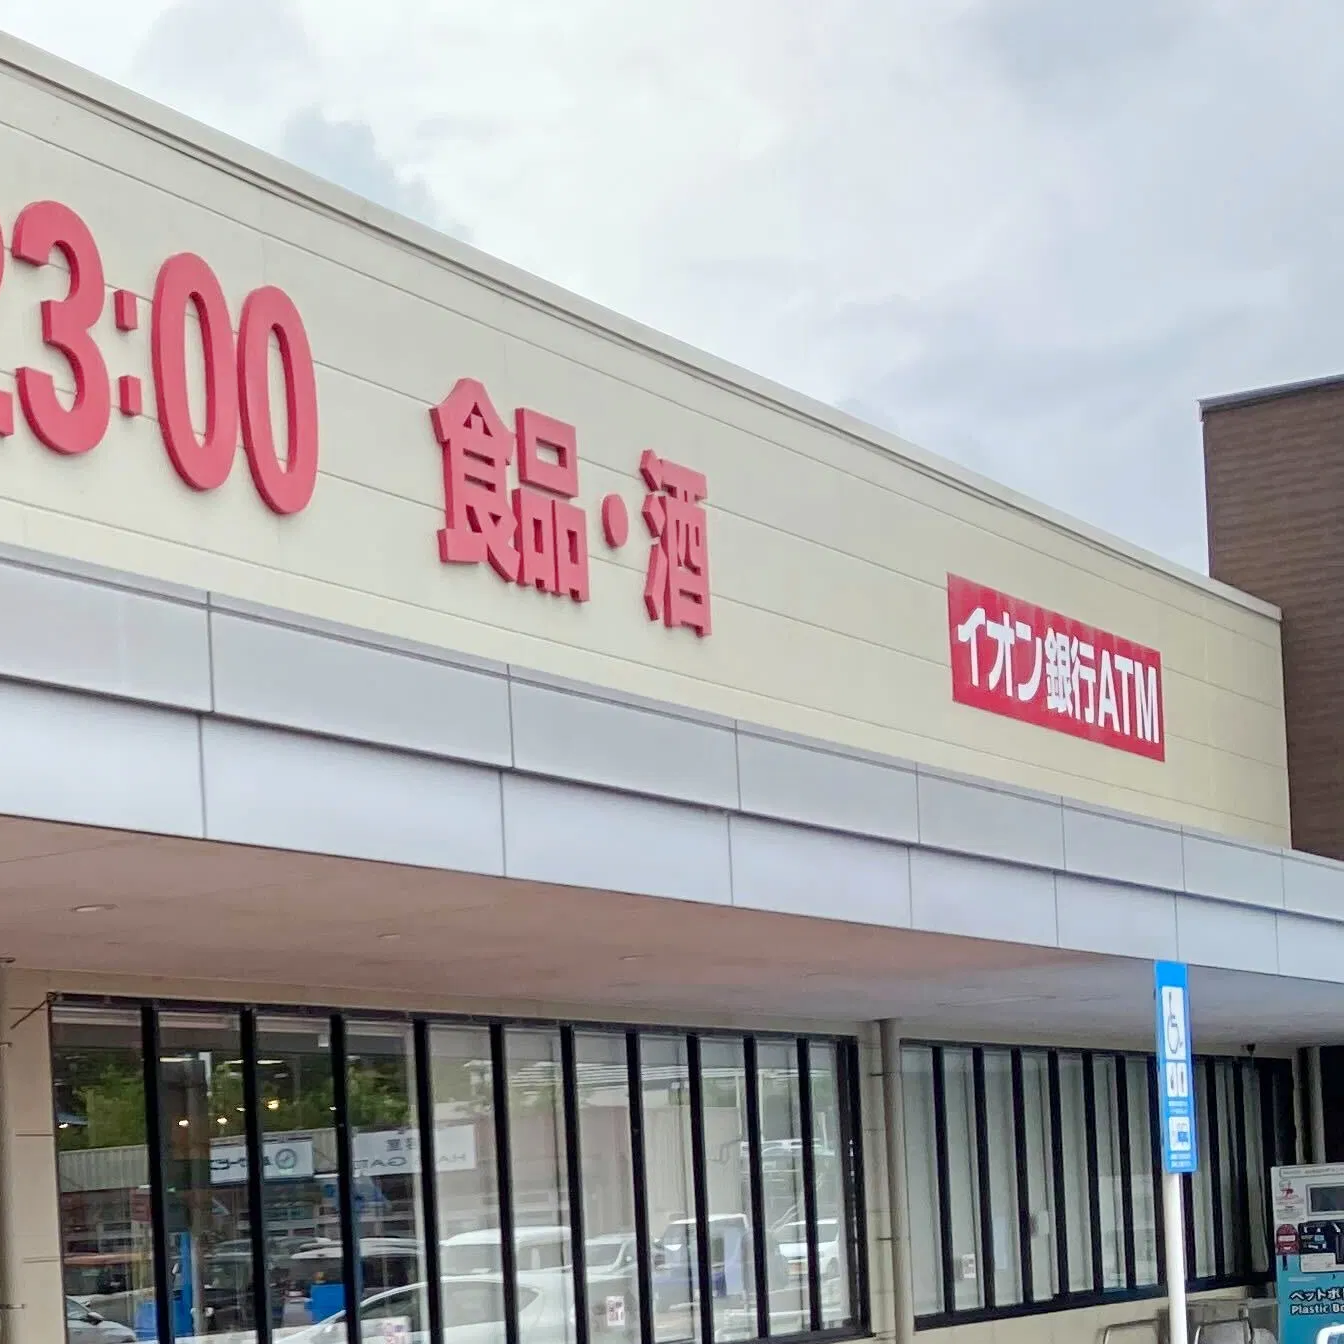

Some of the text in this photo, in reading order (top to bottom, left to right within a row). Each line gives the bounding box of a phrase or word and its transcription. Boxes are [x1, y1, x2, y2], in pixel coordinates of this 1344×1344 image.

[430, 376, 713, 637] 食品・酒
[957, 607, 1162, 745] イオン銀行ATM
